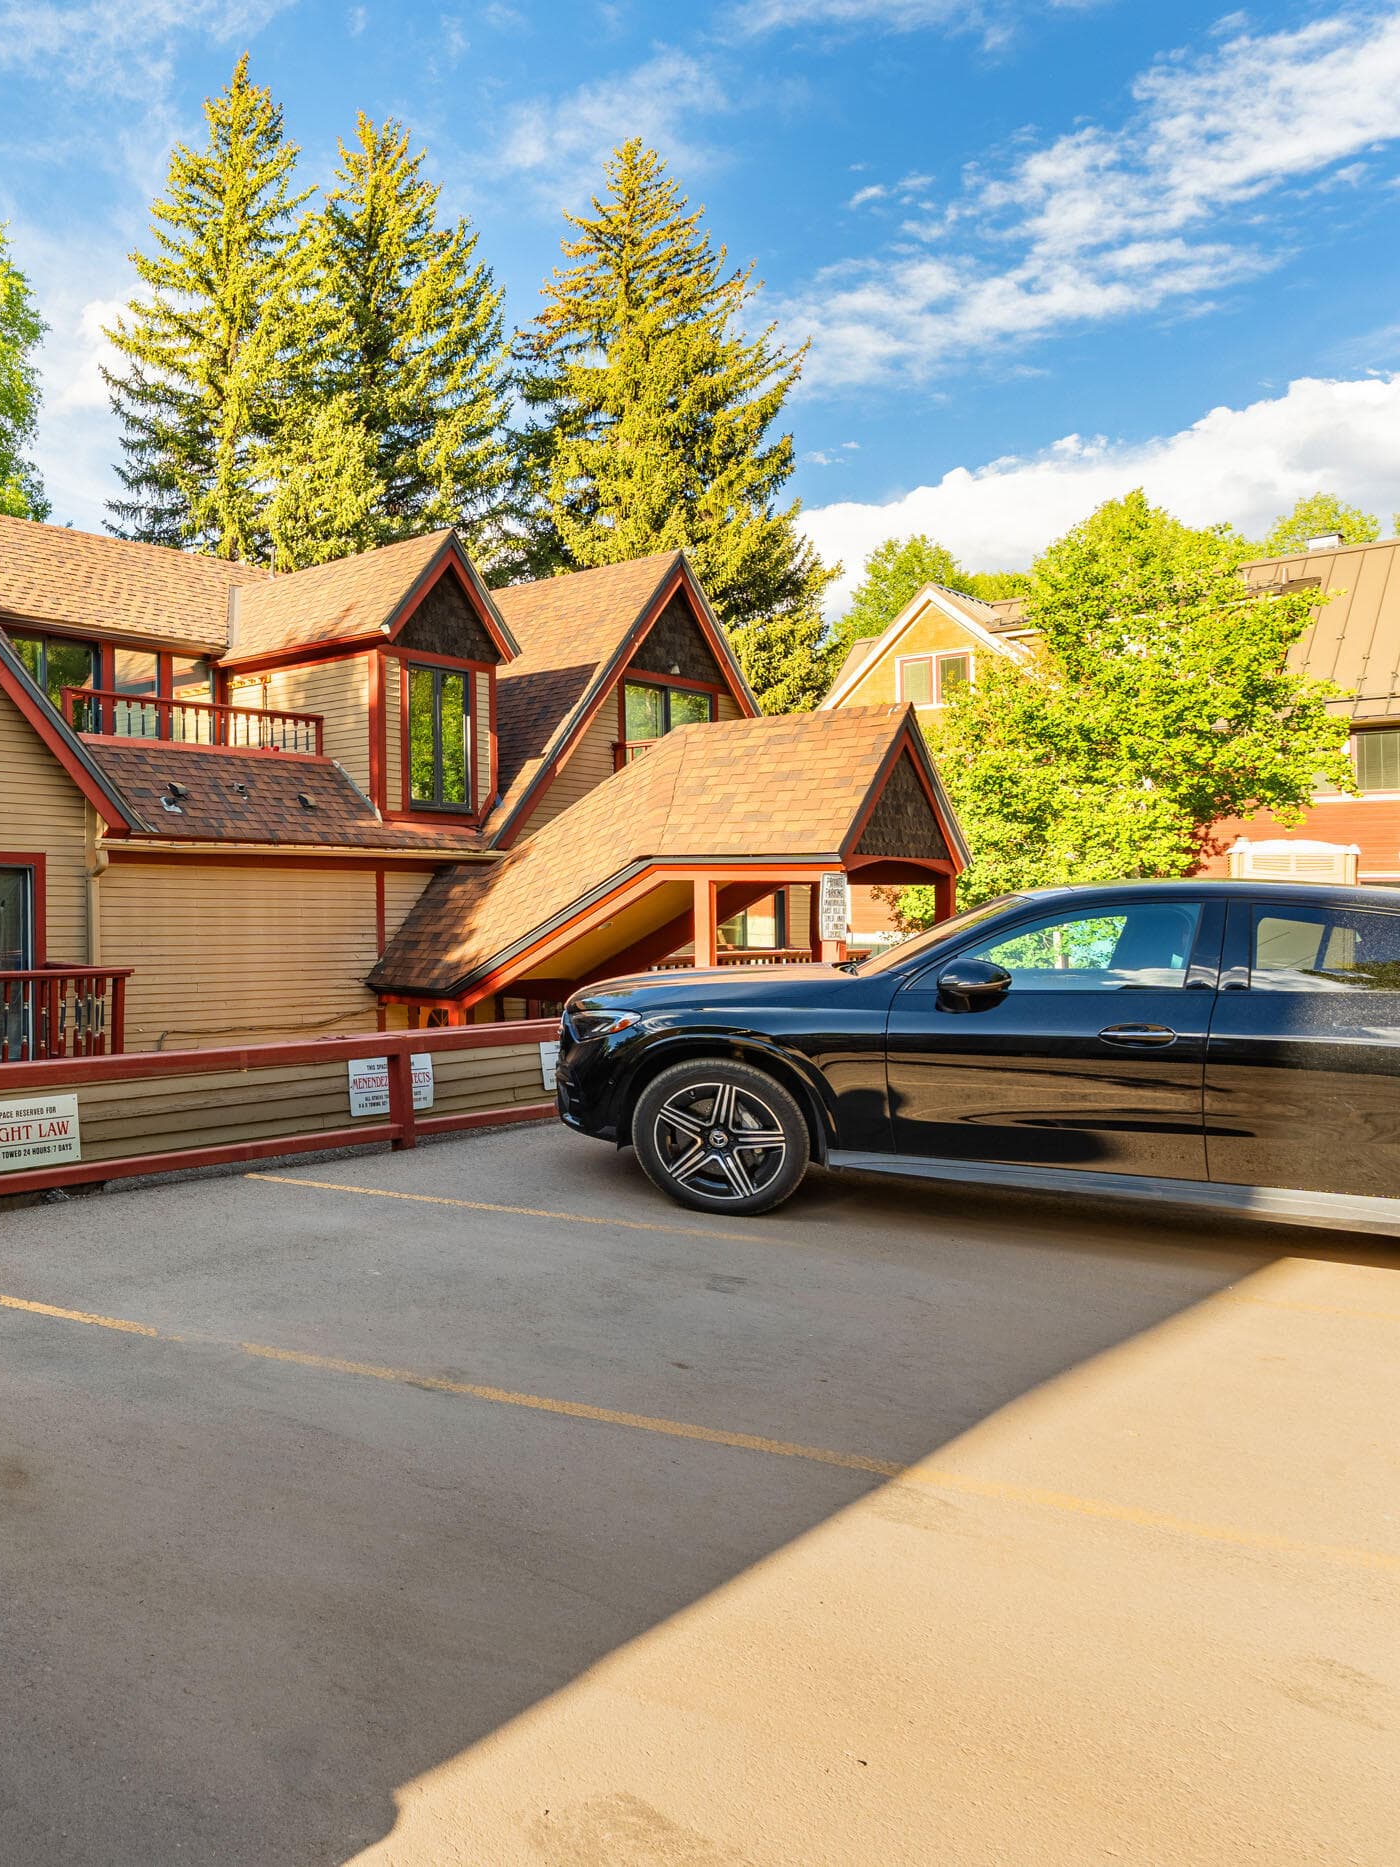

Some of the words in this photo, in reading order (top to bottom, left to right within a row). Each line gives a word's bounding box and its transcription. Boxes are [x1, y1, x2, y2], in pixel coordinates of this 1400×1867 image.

[353, 1076, 388, 1090] MENENDEZ
[16, 1108, 44, 1116] RESERVED
[46, 1106, 56, 1114] FOR
[38, 1121, 69, 1137] LAW
[2, 1150, 21, 1159] TOWED
[58, 1144, 72, 1152] DAYS
